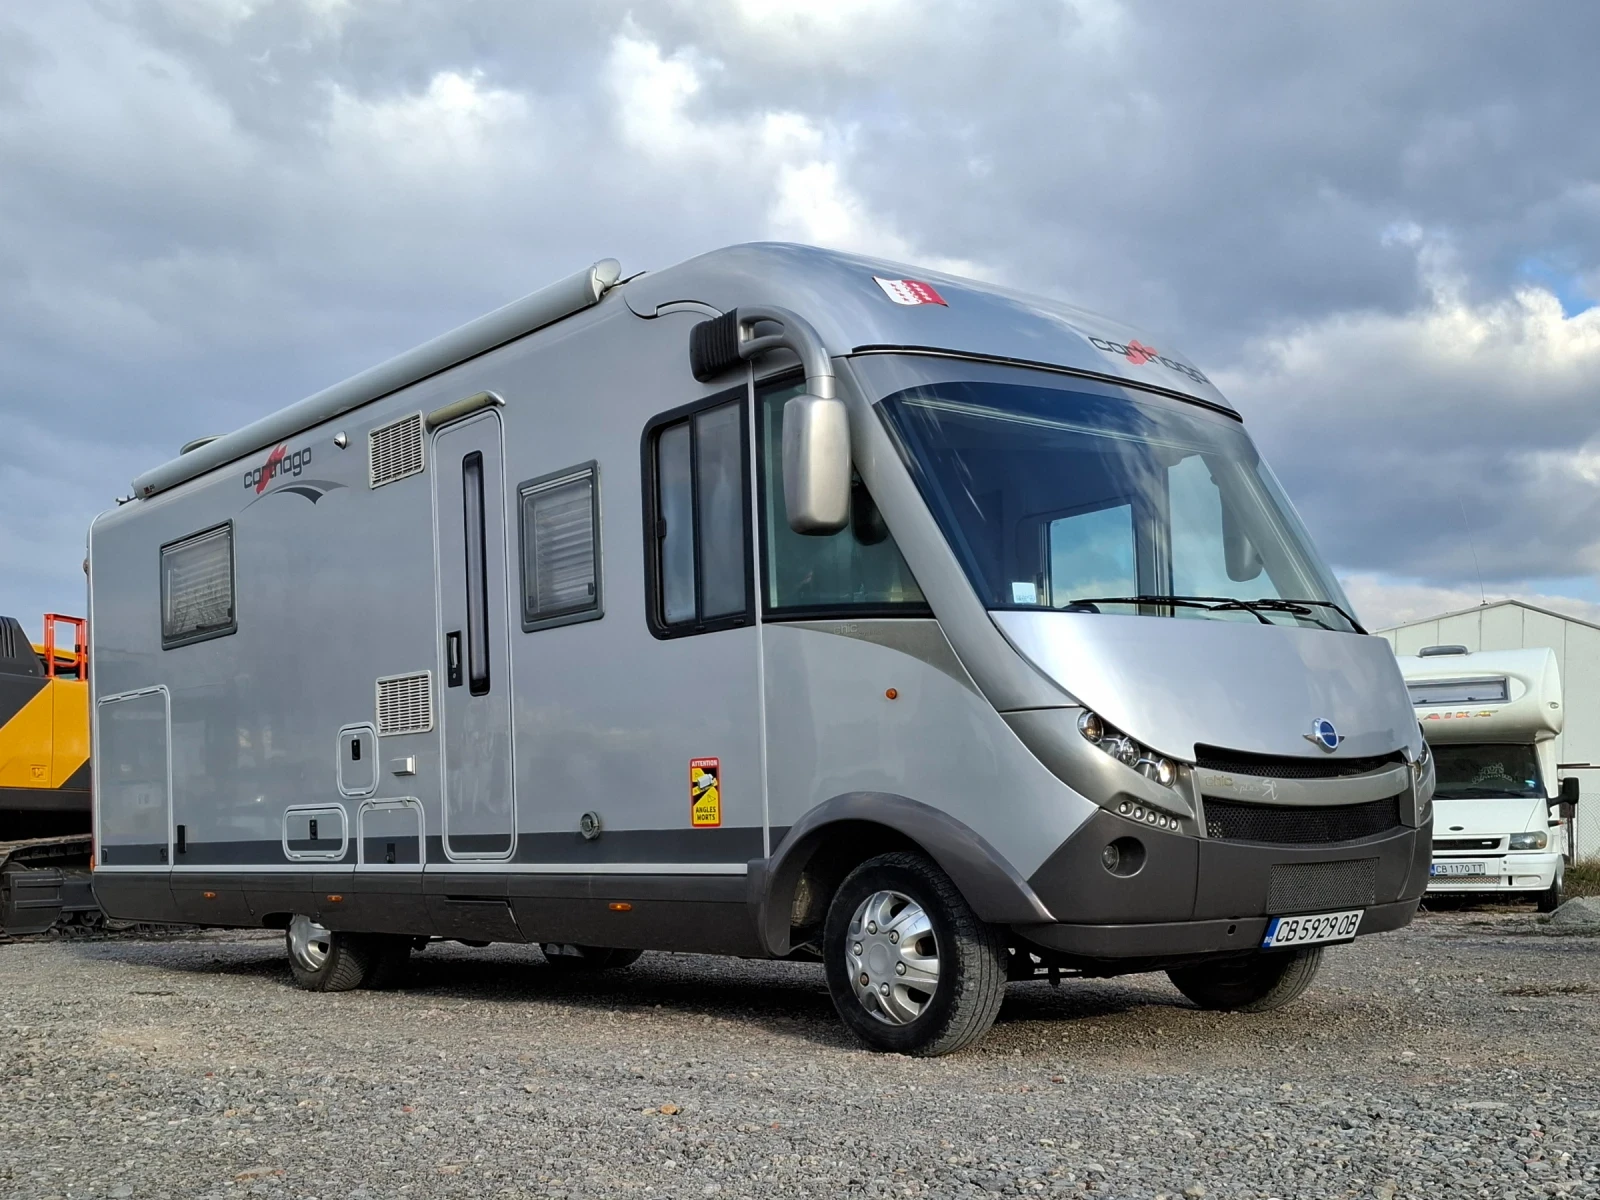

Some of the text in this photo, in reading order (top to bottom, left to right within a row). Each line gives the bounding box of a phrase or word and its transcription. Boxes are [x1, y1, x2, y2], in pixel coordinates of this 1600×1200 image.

[244, 446, 312, 489] carthago
[1416, 709, 1498, 720] AIKA
[1450, 864, 1470, 873] 1170
